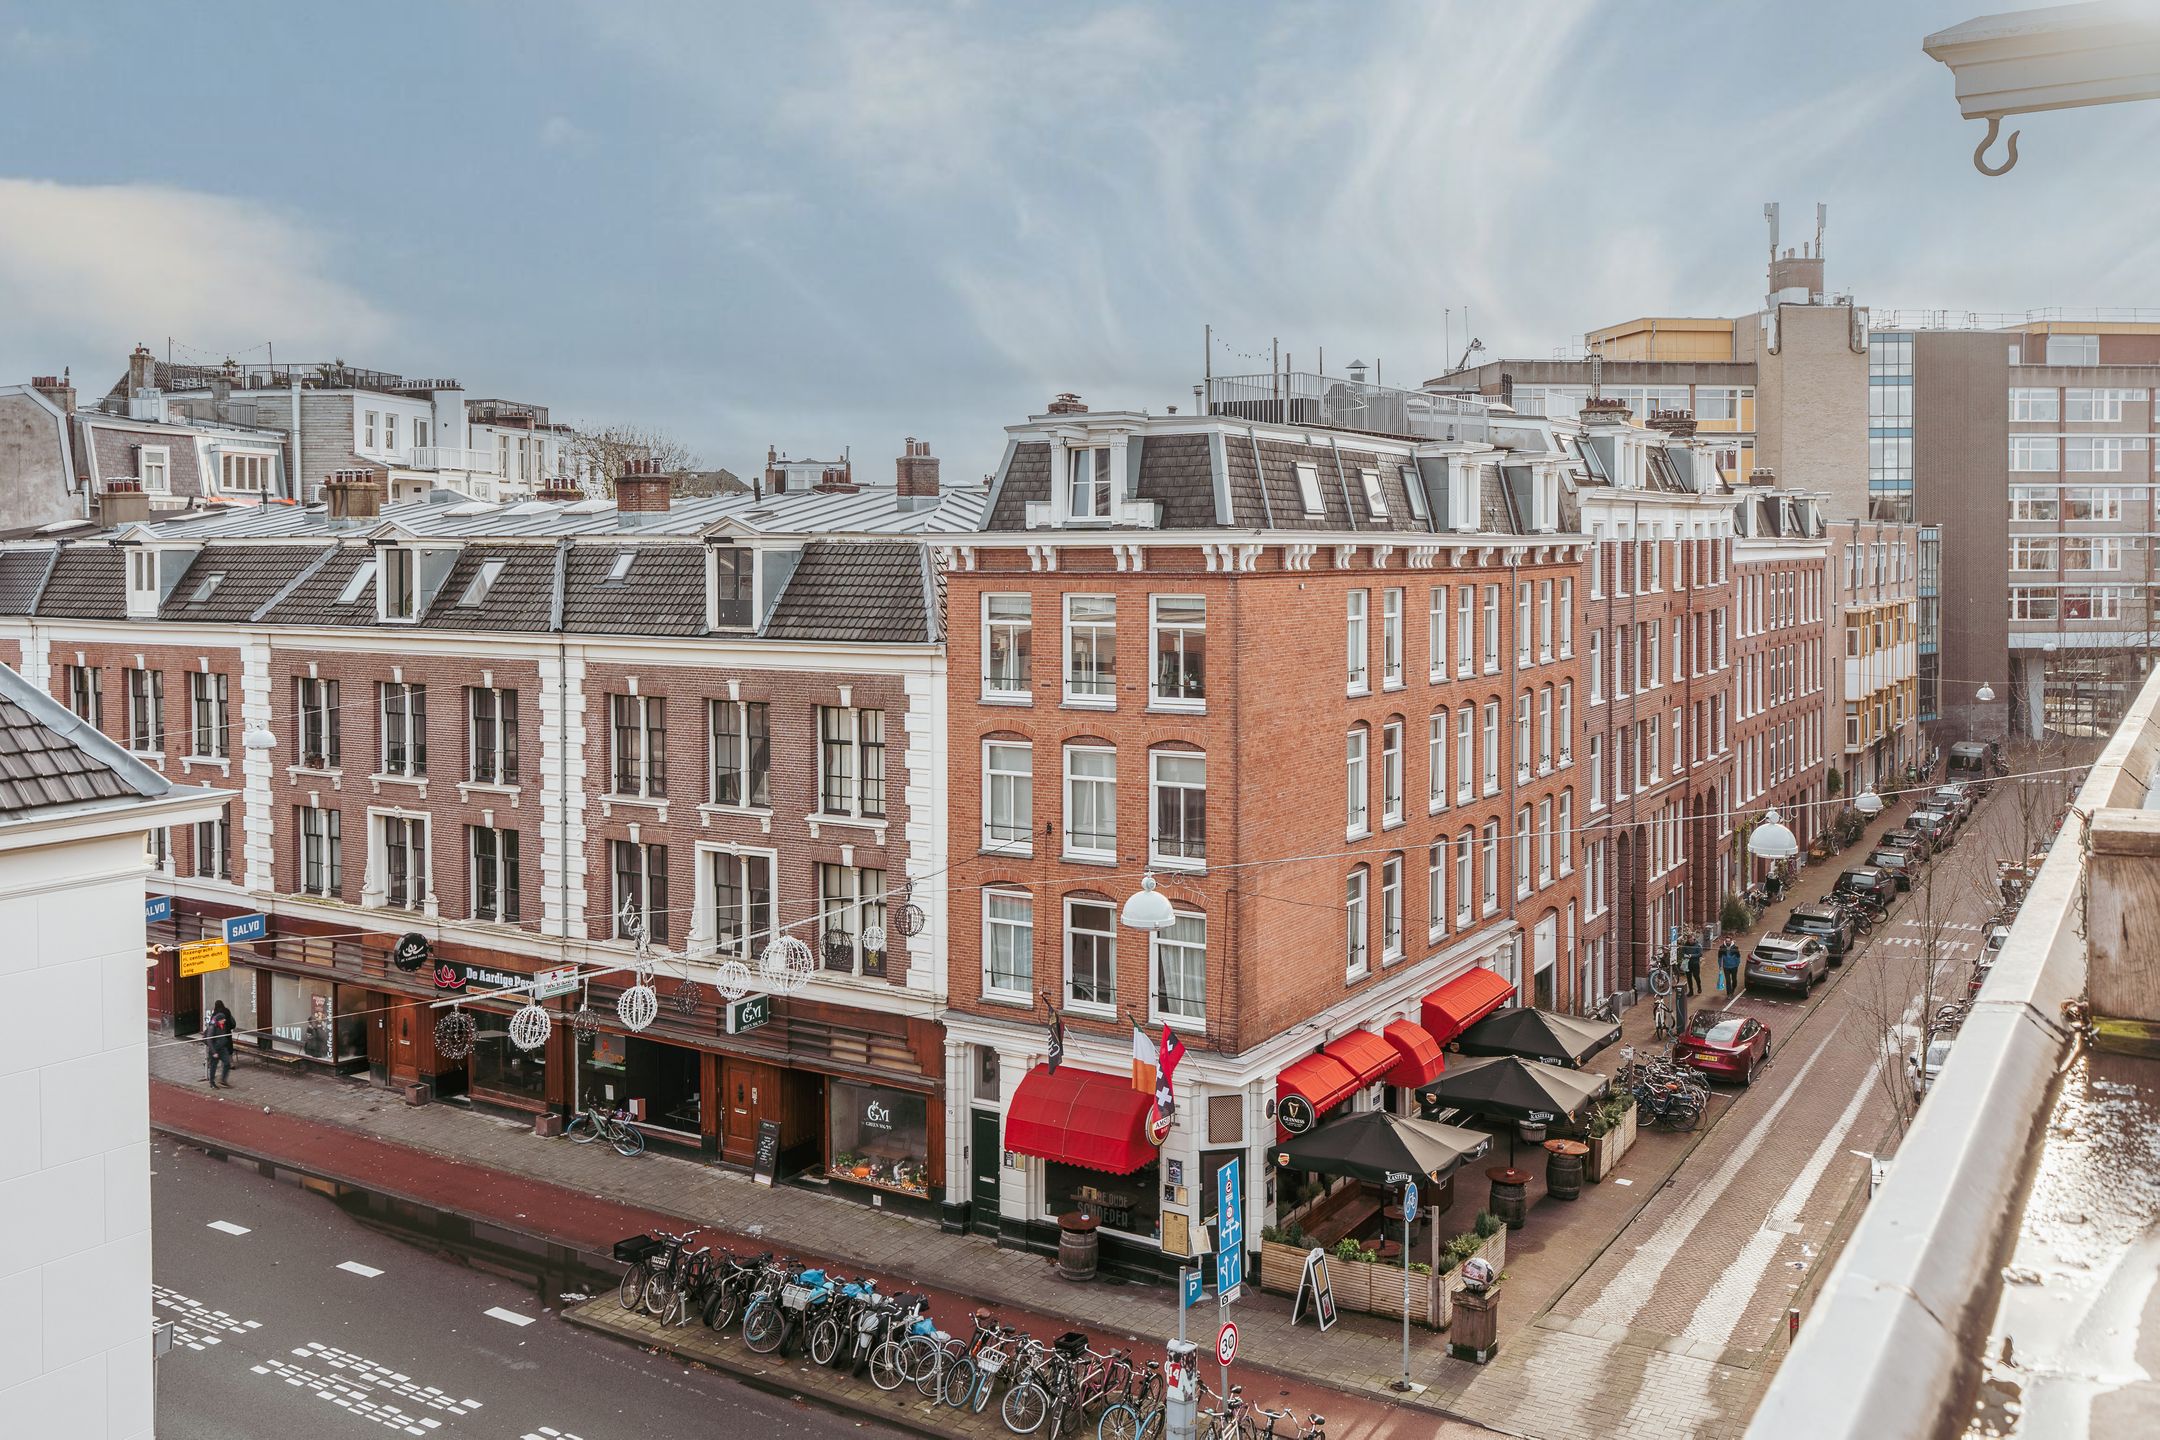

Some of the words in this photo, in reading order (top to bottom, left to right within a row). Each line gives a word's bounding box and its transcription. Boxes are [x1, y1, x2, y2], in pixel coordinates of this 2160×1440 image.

[146, 902, 165, 917] ALVO
[232, 920, 260, 938] SALVO
[466, 967, 478, 980] De
[479, 969, 514, 988] Aardige
[275, 1026, 302, 1041] SALVO
[1387, 1173, 1409, 1181] KASTEEL
[1189, 1281, 1197, 1297] P
[1221, 1333, 1235, 1355] 30
